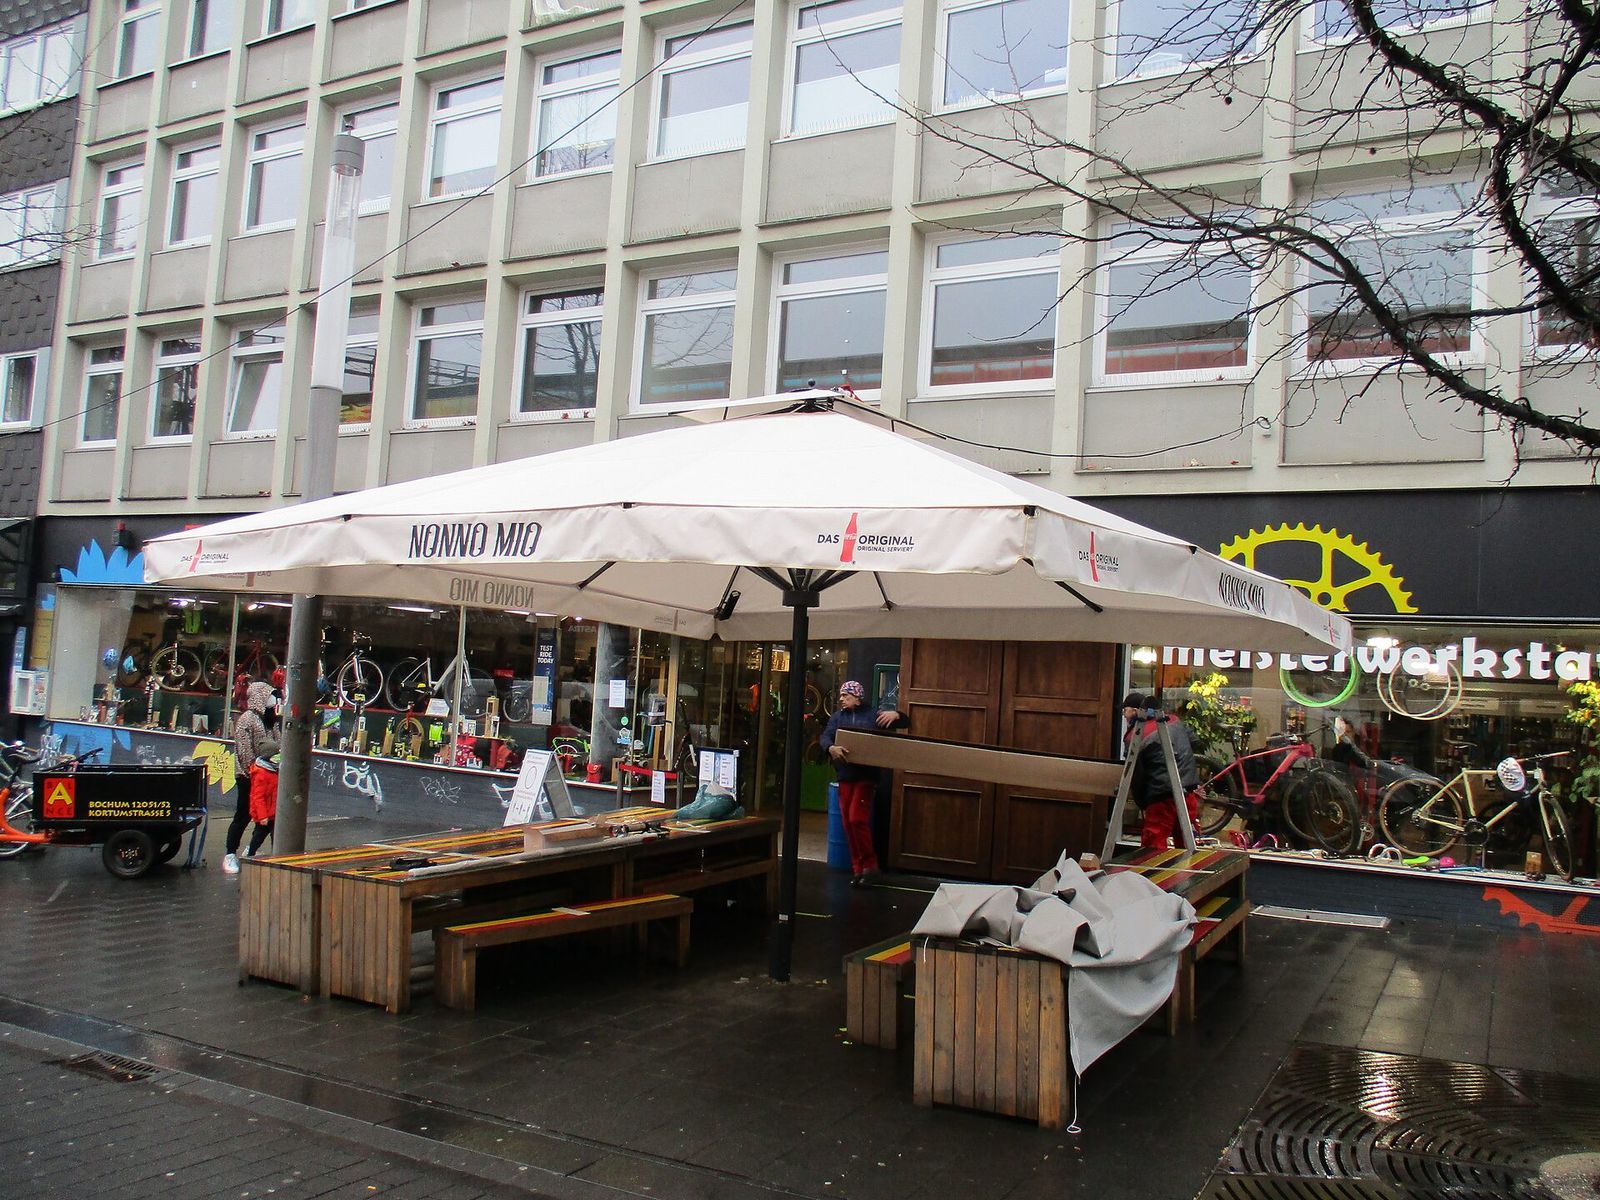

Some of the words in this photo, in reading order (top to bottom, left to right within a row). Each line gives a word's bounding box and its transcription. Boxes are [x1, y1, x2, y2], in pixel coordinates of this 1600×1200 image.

[408, 522, 488, 558] NONNO
[492, 522, 543, 557] MIO
[817, 534, 840, 544] DAS
[859, 535, 915, 546] ORIGINAL
[857, 545, 886, 553] ORIGINAL
[200, 553, 230, 561] ORIGINAL
[1078, 550, 1089, 561] DAS
[1095, 553, 1119, 567] ORIGINAL
[1163, 637, 1600, 680] mesterwerksta
[89, 801, 130, 809] BOCHUM
[132, 801, 171, 809] 12051/52
[88, 809, 164, 817] KORTUMSTRASSE
[166, 809, 171, 817] 5
